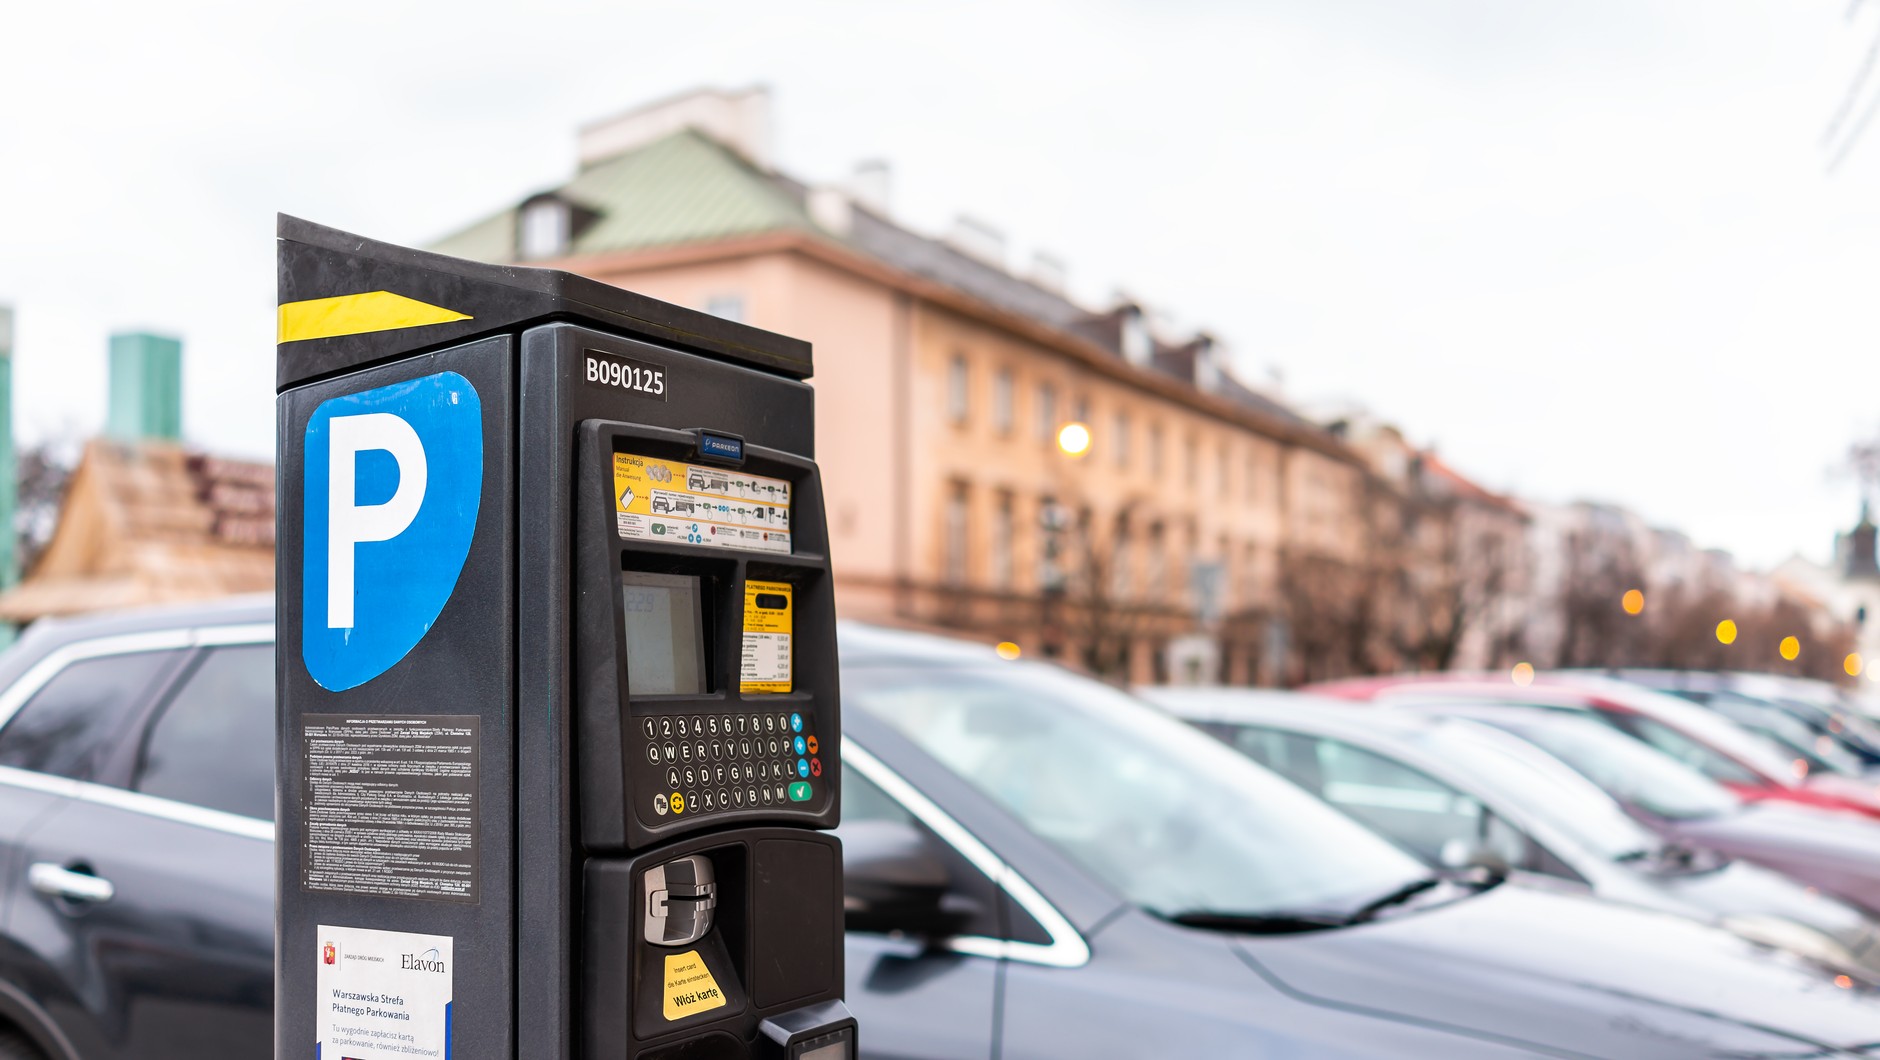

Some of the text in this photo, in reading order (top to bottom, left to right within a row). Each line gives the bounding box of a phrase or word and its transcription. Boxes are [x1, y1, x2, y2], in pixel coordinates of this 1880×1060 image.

[586, 358, 664, 394] B090125
[616, 456, 644, 467] Instrukcja
[327, 412, 427, 628] P
[647, 716, 787, 736] 1 2 3 4 5 6 7 8 9 0
[650, 741, 790, 760] Q W E R T Y U I O P
[670, 763, 794, 784] A S D F G H J K L
[690, 787, 785, 808] Z X C V B N M
[401, 953, 445, 973] Elavon
[673, 965, 687, 973] Insert
[332, 989, 404, 1005] Warszawska Strefa
[673, 988, 719, 1007] Włóż kartę
[332, 1003, 410, 1021] Płatnego Parkowania
[332, 1024, 415, 1043] Tu wygodnie zapłacisz kartą
[339, 1037, 376, 1049] parkowanie,
[376, 1041, 400, 1052] również
